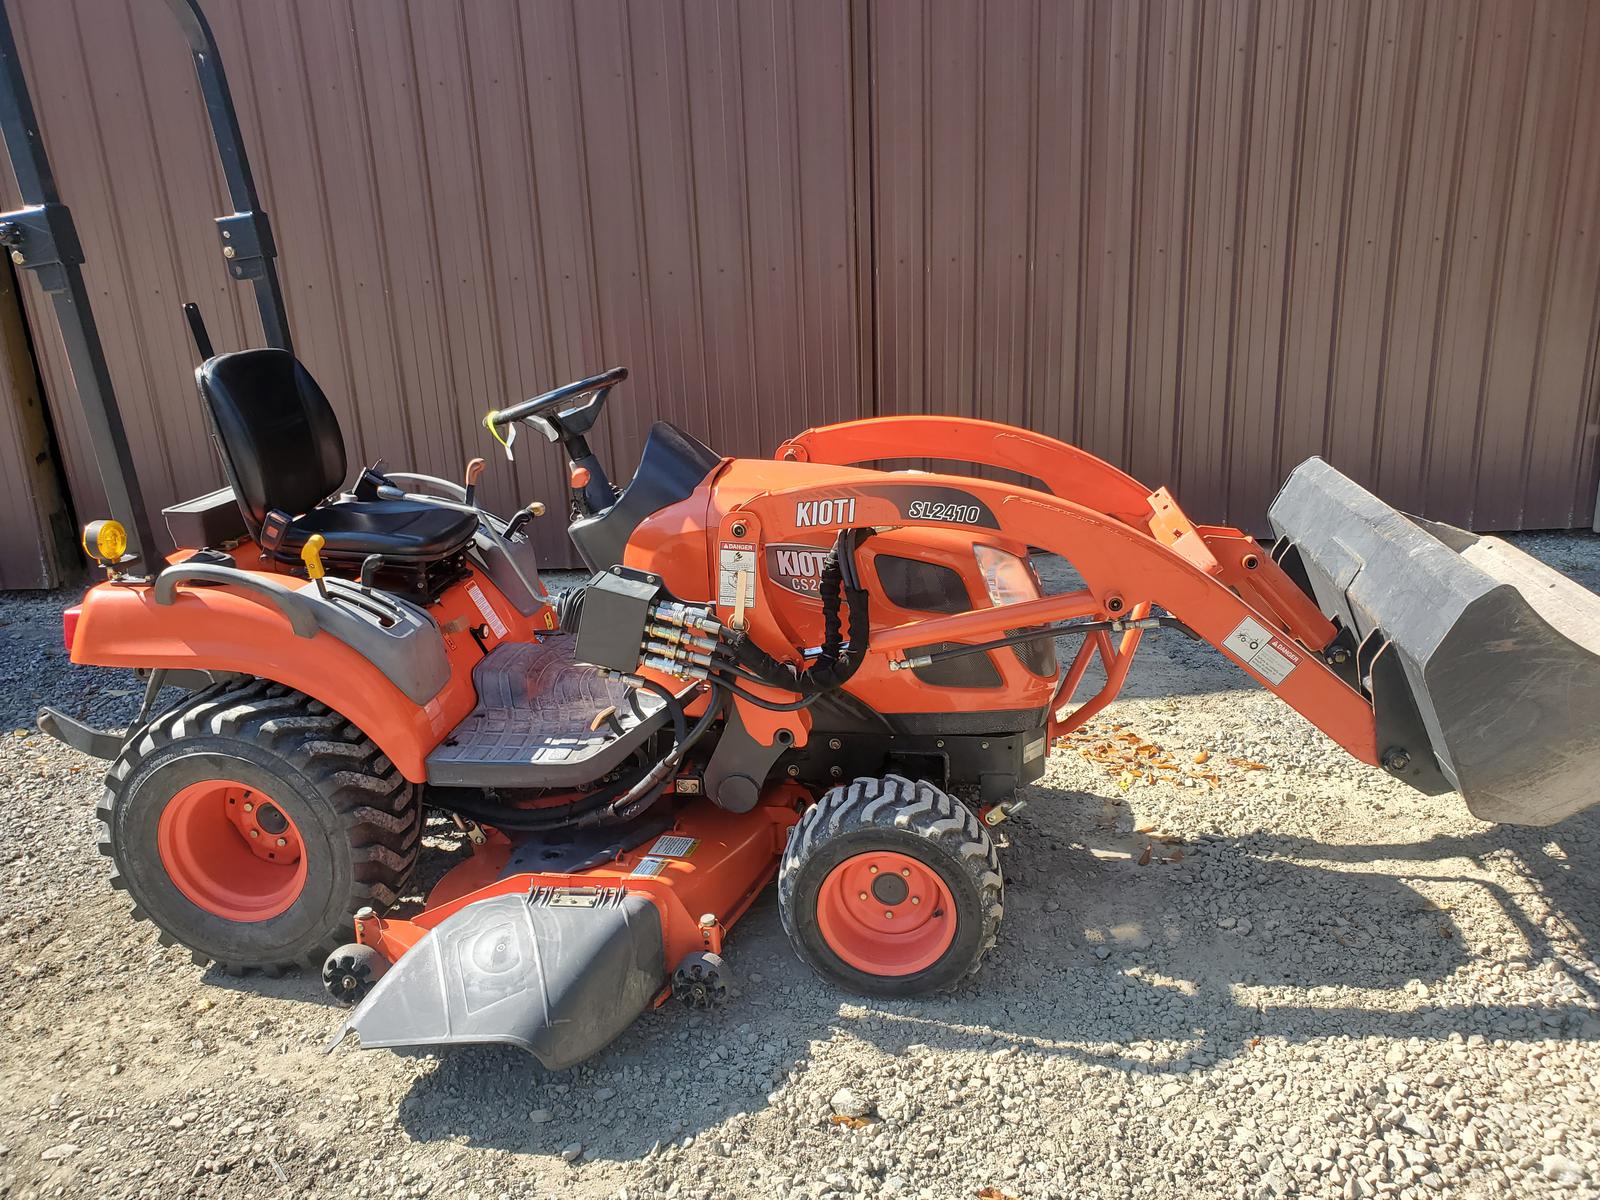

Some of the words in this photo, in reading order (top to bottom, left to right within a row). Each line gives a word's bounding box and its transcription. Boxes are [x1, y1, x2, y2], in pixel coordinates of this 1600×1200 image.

[796, 498, 855, 527] KIOTI
[908, 501, 980, 523] SL2410
[728, 543, 753, 551] DANGER
[776, 550, 830, 577] KIOT
[1276, 643, 1299, 663] DANGER
